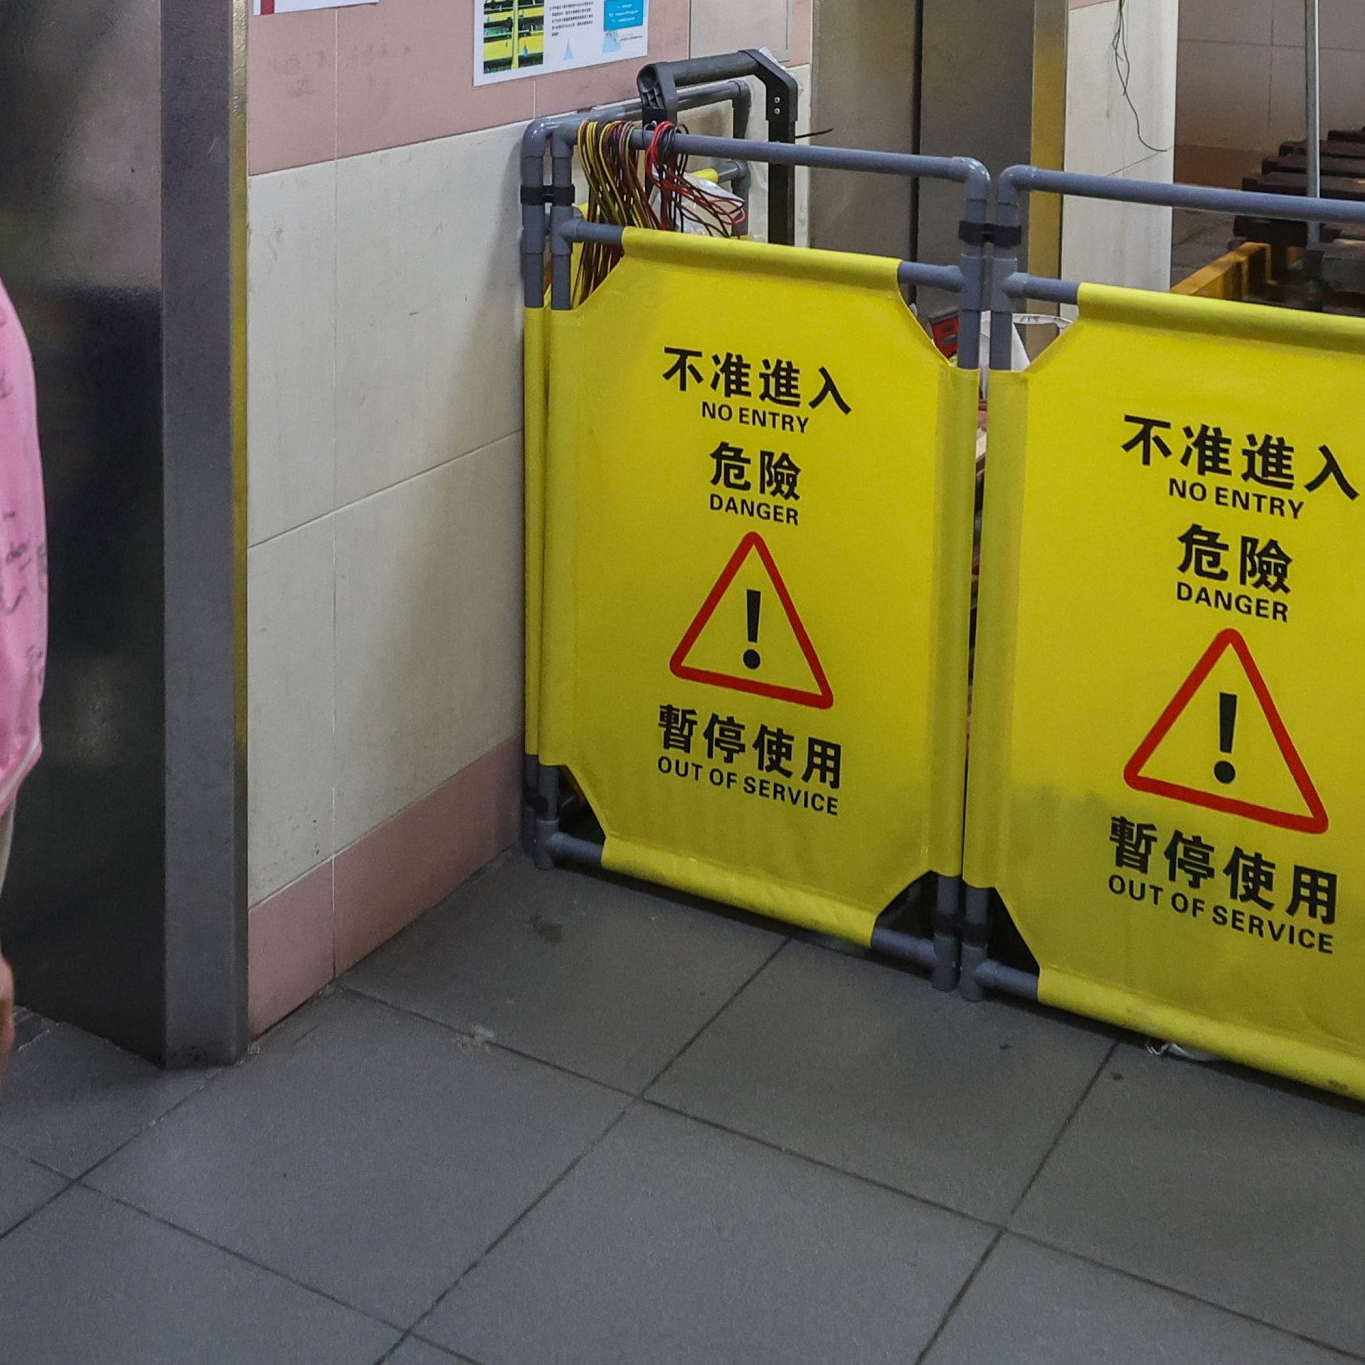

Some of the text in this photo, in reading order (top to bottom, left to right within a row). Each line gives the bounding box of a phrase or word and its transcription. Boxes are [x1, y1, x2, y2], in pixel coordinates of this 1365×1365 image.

[662, 346, 852, 415] 不准進入
[701, 401, 809, 434] NO ENTRY
[709, 441, 801, 502] 危險
[1121, 413, 1361, 502] 不准進入
[709, 493, 799, 526] DANGER
[1168, 477, 1305, 520] NO ENTRY
[1177, 523, 1293, 595] 危險
[1176, 582, 1290, 624] DANGER
[658, 703, 843, 790] 暫停使用
[657, 755, 839, 816] OUT OF SERVICE
[1109, 816, 1339, 927] 暫停使用
[1108, 874, 1335, 955] OUT OF SERVICE
